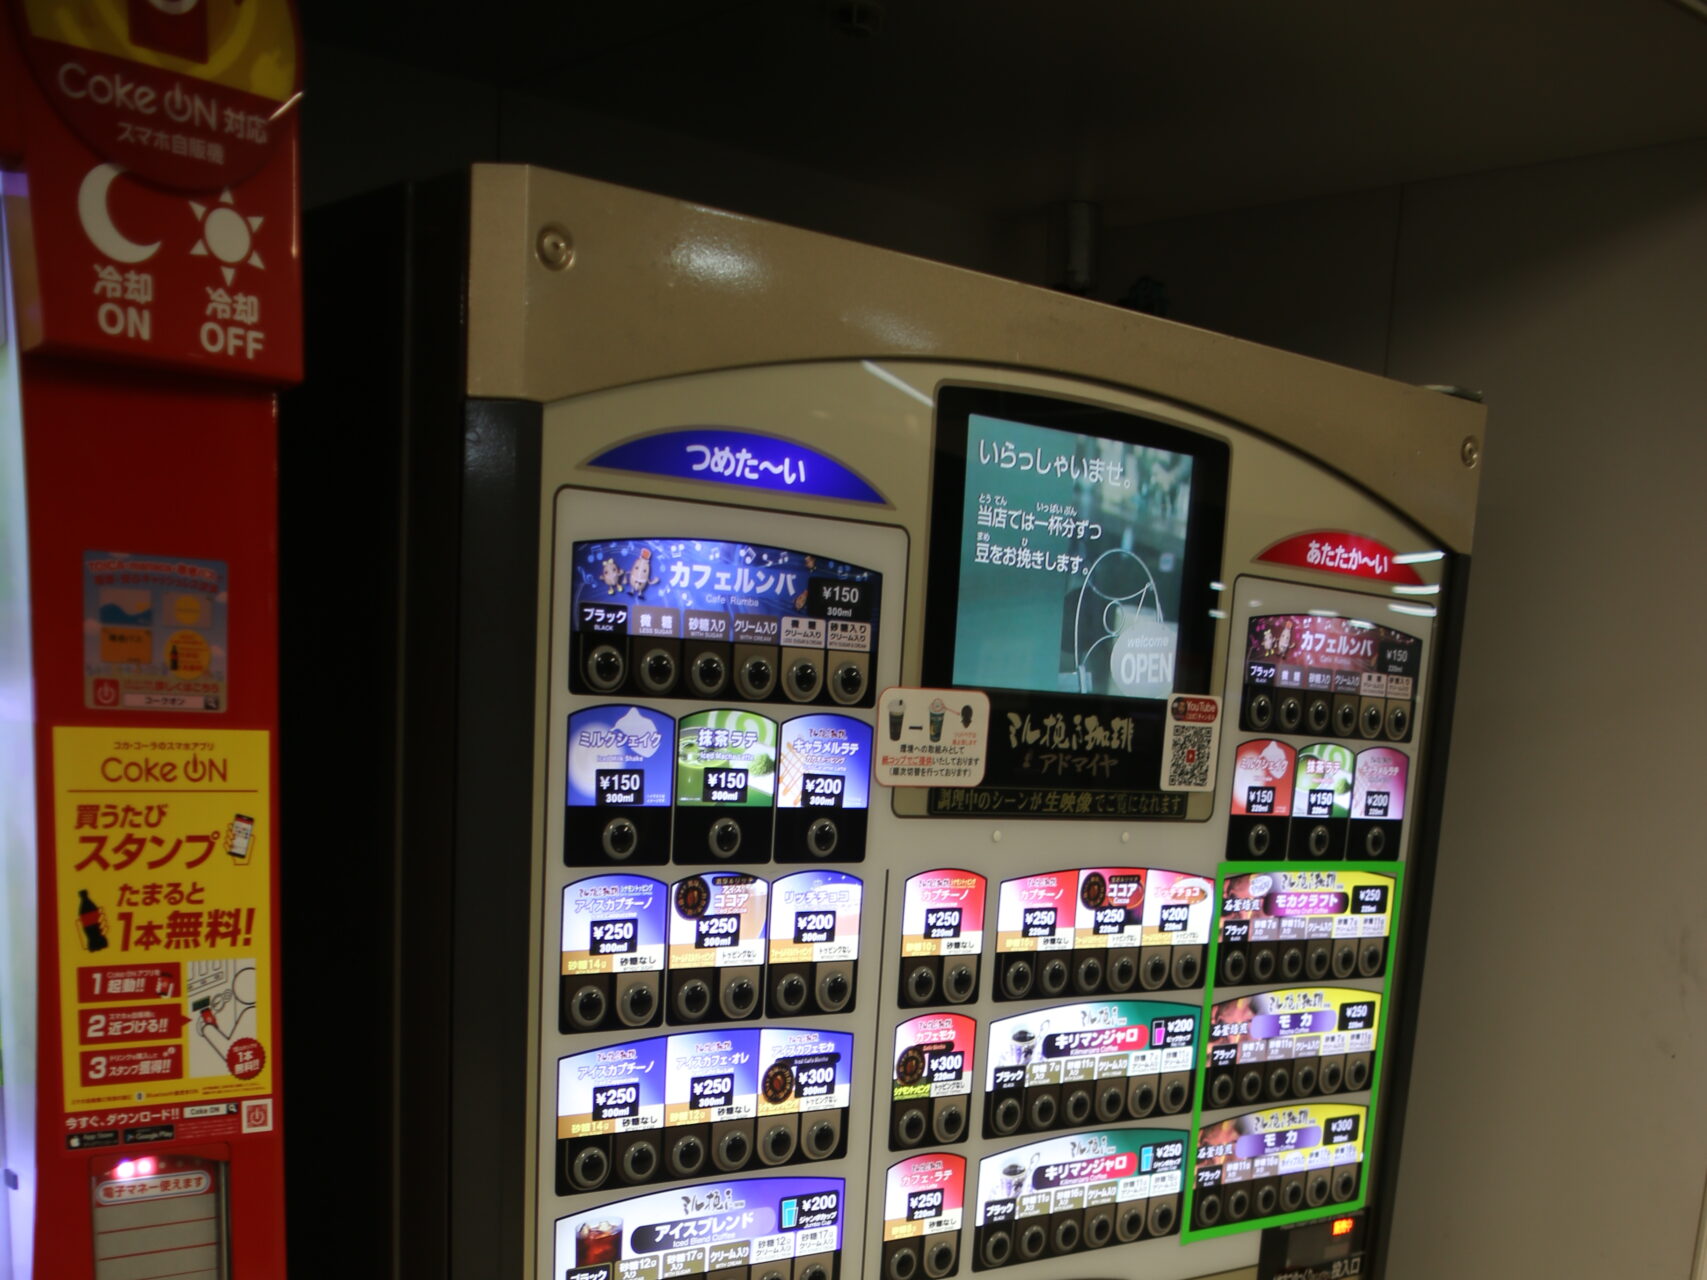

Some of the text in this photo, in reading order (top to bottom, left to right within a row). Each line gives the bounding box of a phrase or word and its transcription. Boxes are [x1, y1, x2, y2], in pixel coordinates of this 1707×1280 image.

[58, 62, 156, 115] Coke
[223, 107, 269, 144] 対応
[94, 264, 153, 304] 冷却
[205, 287, 259, 324] 冷却
[98, 303, 150, 341] ON
[200, 323, 264, 359] OFF
[979, 440, 1131, 488] いらっしゃいませ。
[977, 505, 1102, 540] 当店では一杯分ずつ
[975, 542, 1089, 575] 豆をお挽きします。
[670, 561, 797, 596] カフェルンバ
[822, 586, 859, 604] ¥150
[583, 607, 627, 624] ブラック
[827, 606, 852, 617] 300ml
[688, 617, 726, 633] 砂糖入り
[734, 618, 778, 634] クリーム入り
[1127, 635, 1169, 648] welcome
[1300, 631, 1374, 657] カフェルンバ
[1121, 653, 1173, 685] OPEN
[1187, 701, 1216, 713] YouTube
[113, 741, 215, 751] コカ・コーラのスマホアプリ
[579, 729, 662, 750] ミルクシェイク
[699, 728, 757, 748] 抹茶ラテ
[793, 739, 859, 756] キャラメルラテ
[101, 753, 228, 783] Coke ON
[1040, 753, 1118, 777] アドマイヤ
[600, 774, 640, 791] ¥150
[708, 772, 746, 789] ¥150
[805, 778, 842, 795] ¥200
[606, 793, 634, 803] 300ml
[711, 791, 738, 802] 300ml
[809, 796, 835, 806] 300ml
[1249, 790, 1274, 804] ¥150
[1309, 793, 1332, 806] ¥150
[1367, 794, 1388, 807] ¥200
[75, 804, 168, 829] 買うたび
[74, 831, 220, 872] スタンプ
[116, 882, 205, 907] たまると
[784, 890, 850, 904] リッチチョコ
[920, 887, 970, 901] カプチーノ
[1020, 888, 1064, 901] カプチーノ
[1107, 883, 1137, 898] ココア
[1359, 888, 1382, 902] ¥250
[574, 896, 654, 913] アイスカプチーノ
[714, 893, 750, 909] ココア
[1275, 893, 1339, 909] モカクラフト
[927, 911, 960, 927] ¥250
[1025, 911, 1055, 926] ¥250
[1096, 909, 1125, 924] ¥250
[1161, 906, 1188, 921] ¥200
[117, 908, 256, 952] 1本無料!
[699, 918, 737, 935] ¥250
[797, 914, 834, 931] ¥200
[593, 923, 633, 940] ¥250
[620, 955, 657, 967] 砂糖なし
[91, 972, 102, 995] 1
[1346, 1006, 1368, 1019] ¥250
[87, 1014, 106, 1038] 2
[108, 1018, 169, 1036] 近づける!!
[1167, 1018, 1194, 1033] ¥200
[913, 1028, 956, 1042] カフェモカ
[1055, 1029, 1138, 1050] キリマンジャロ
[238, 1049, 253, 1062] 1本
[771, 1042, 835, 1057] アイスカフェモカ
[88, 1056, 107, 1080] 3
[676, 1052, 750, 1070] アイスカフェ・オレ
[930, 1055, 962, 1071] ¥300
[577, 1061, 654, 1079] アイスカプチーノ
[799, 1068, 834, 1085] ¥300
[996, 1069, 1024, 1083] ブラック
[693, 1078, 732, 1095] ¥250
[596, 1087, 636, 1105] ¥250
[717, 1104, 751, 1116] 砂糖なし
[65, 1108, 180, 1130] 今すぐ、ダウンロード!!
[622, 1115, 658, 1127] 砂糖なし
[1331, 1119, 1352, 1132] ¥300
[1156, 1143, 1182, 1158] ¥250
[1045, 1156, 1128, 1180] キリマンジャロ
[102, 1175, 204, 1199] 電子マネー使えます
[802, 1194, 837, 1212] ¥200
[910, 1193, 941, 1209] ¥250
[986, 1202, 1014, 1216] ブラック
[654, 1211, 754, 1243] アイスブレンド
[710, 1246, 749, 1263] クリーム入り
